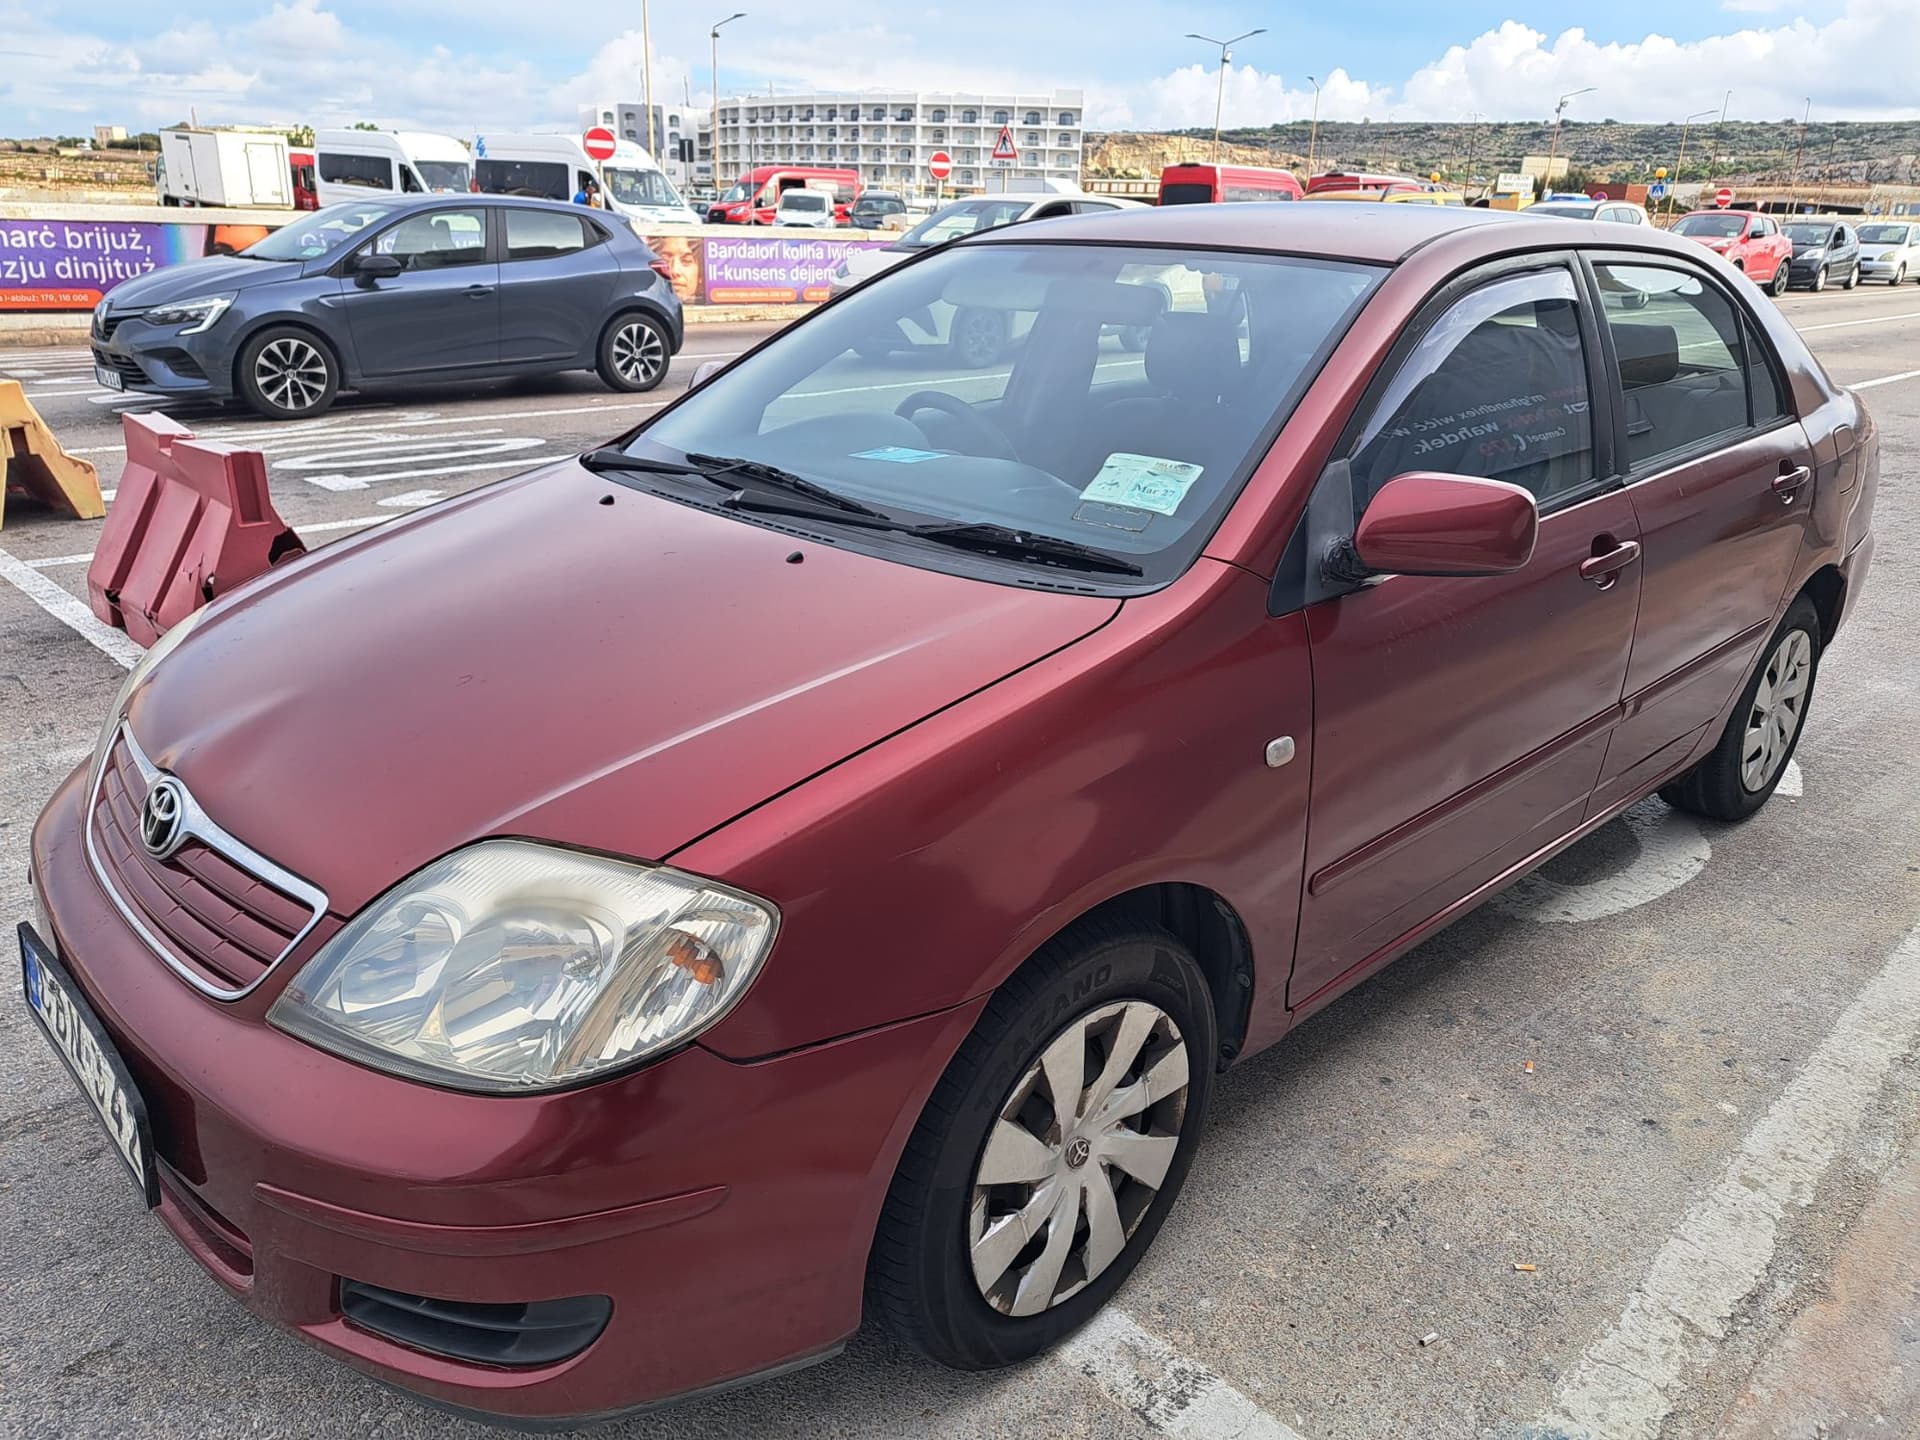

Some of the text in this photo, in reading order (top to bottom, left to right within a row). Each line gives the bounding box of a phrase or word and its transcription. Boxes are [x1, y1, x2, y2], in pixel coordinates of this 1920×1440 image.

[64, 226, 152, 255] brijuż,
[0, 255, 156, 284] zju dinjituż
